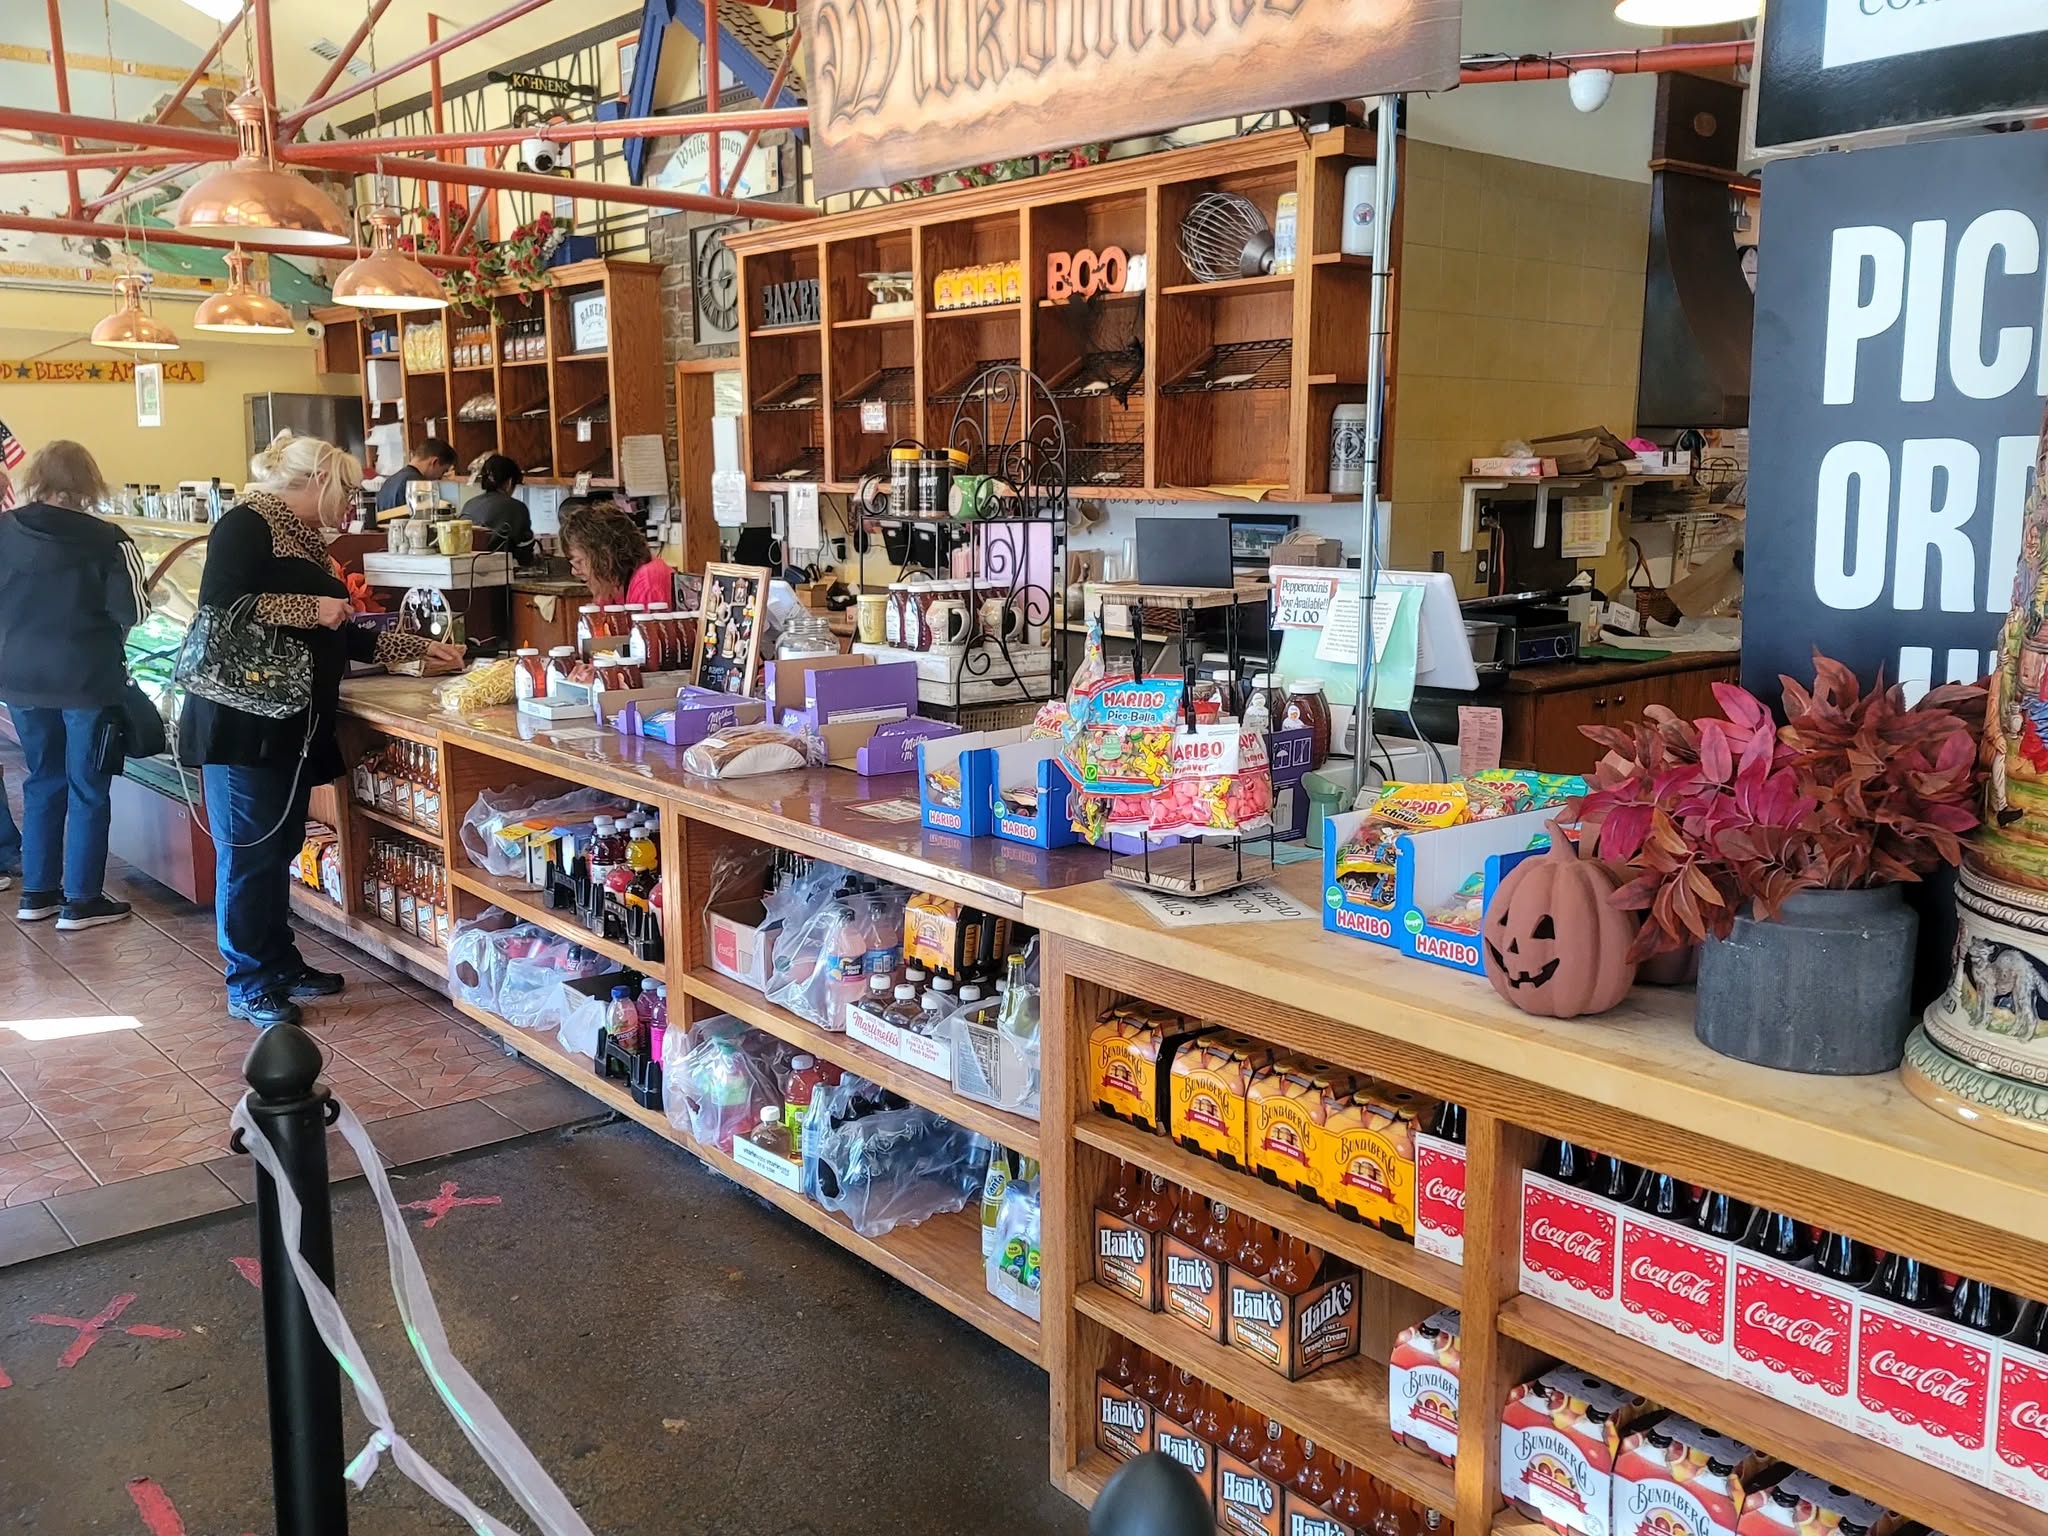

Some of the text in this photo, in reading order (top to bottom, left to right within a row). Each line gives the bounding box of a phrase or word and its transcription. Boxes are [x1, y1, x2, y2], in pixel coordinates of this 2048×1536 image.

[513, 75, 571, 94] KOHNENS
[1047, 246, 1127, 301] BOO
[1823, 209, 2048, 405] PIC
[35, 363, 84, 380] BLESS
[109, 362, 197, 382] AMICA
[1282, 580, 1329, 594] Pepperoncinis
[1283, 608, 1319, 623] $1.00
[1103, 691, 1165, 709] HARIBO
[1107, 710, 1157, 722] Pico-Balla
[1173, 741, 1224, 761] ARIBO
[929, 810, 961, 830] HARIBO
[1001, 820, 1037, 839] HARIBO
[1337, 909, 1391, 937] HARIBO
[1417, 935, 1478, 965] HARIBO
[1180, 1077, 1235, 1121] BUNDABERG
[1257, 1104, 1317, 1151] BUNDABERG
[1335, 1136, 1403, 1187] BUNDABERG
[1101, 1229, 1144, 1263] Hank's
[1531, 1217, 1606, 1264] Coca-Cola
[1168, 1257, 1212, 1293] Hank's
[1630, 1256, 1715, 1305] Coca-Cola
[1233, 1289, 1282, 1327] Hank's
[1300, 1281, 1352, 1343] Hank's
[1237, 1325, 1278, 1353] Orange Cream
[1744, 1301, 1839, 1356] Coca-Cola
[1869, 1350, 1975, 1408] Coca-Cola
[1102, 1397, 1144, 1433] Hank's
[1160, 1433, 1205, 1473] Hank's
[1514, 1431, 1595, 1497] BUNDABERG
[1223, 1471, 1273, 1514] Hank's
